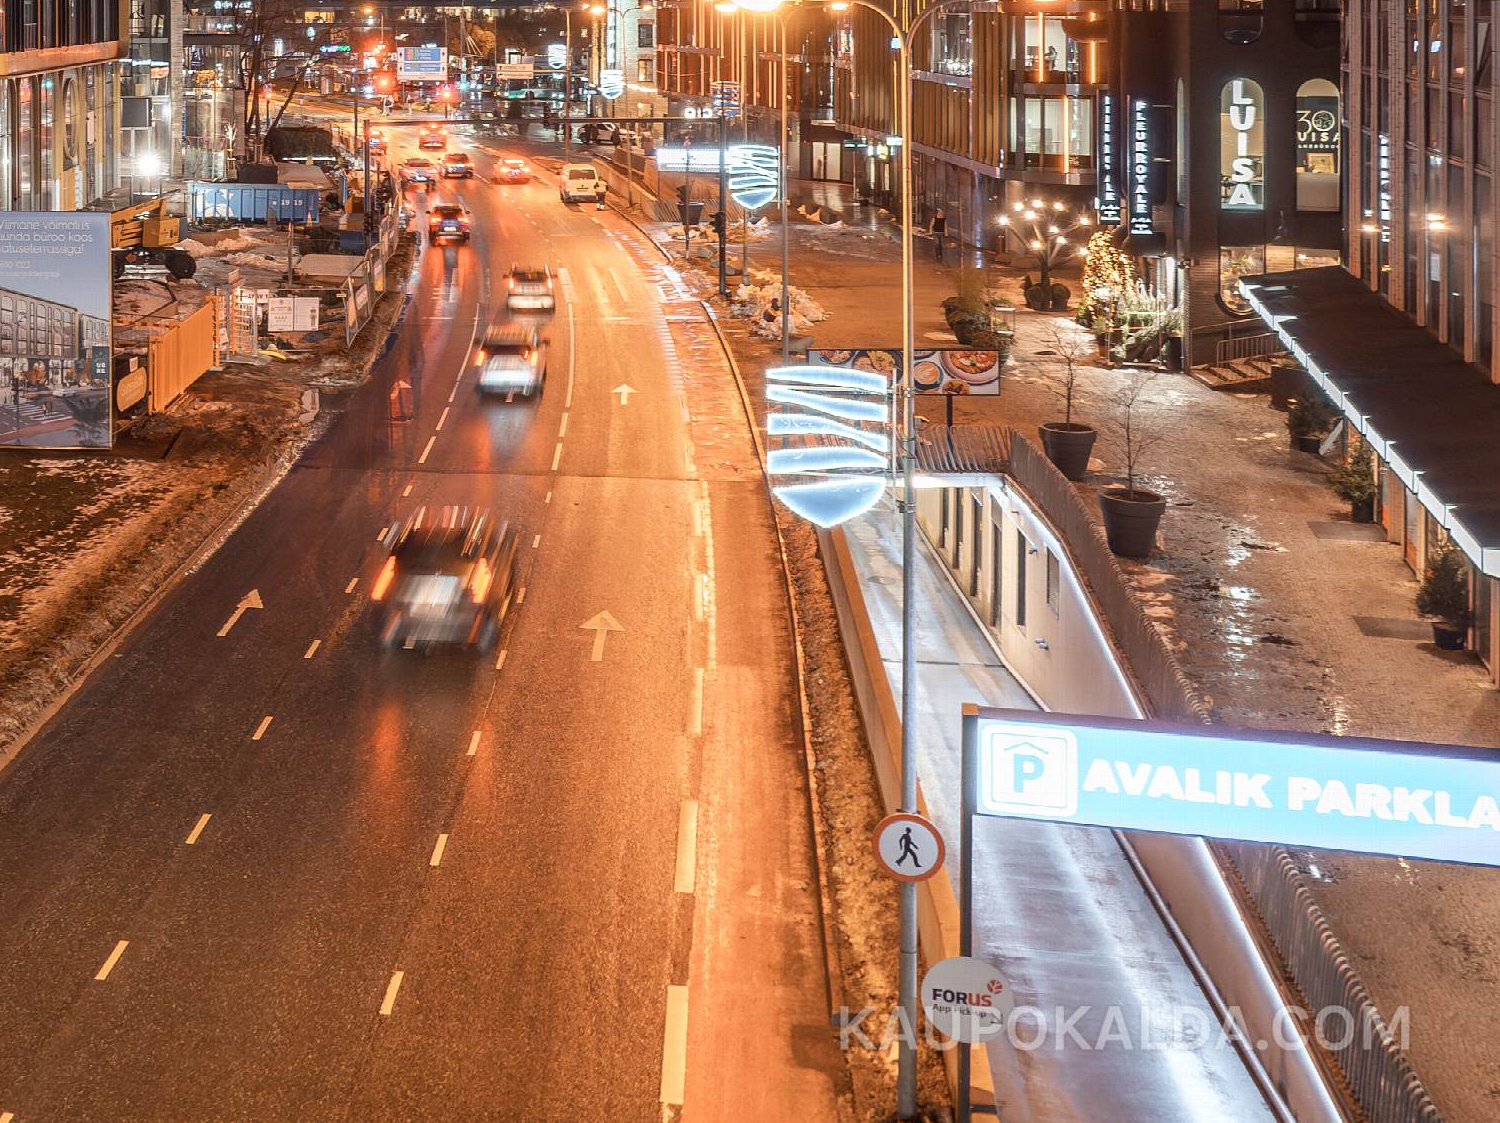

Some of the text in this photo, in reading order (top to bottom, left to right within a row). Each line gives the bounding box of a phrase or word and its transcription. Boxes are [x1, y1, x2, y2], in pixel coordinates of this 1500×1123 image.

[1229, 80, 1257, 205] LUISA
[1297, 132, 1341, 142] UISA
[68, 232, 93, 243] koos
[1082, 758, 1274, 809] AVALIK
[1287, 775, 1500, 832] PARKLA
[932, 988, 992, 1007] FORUS
